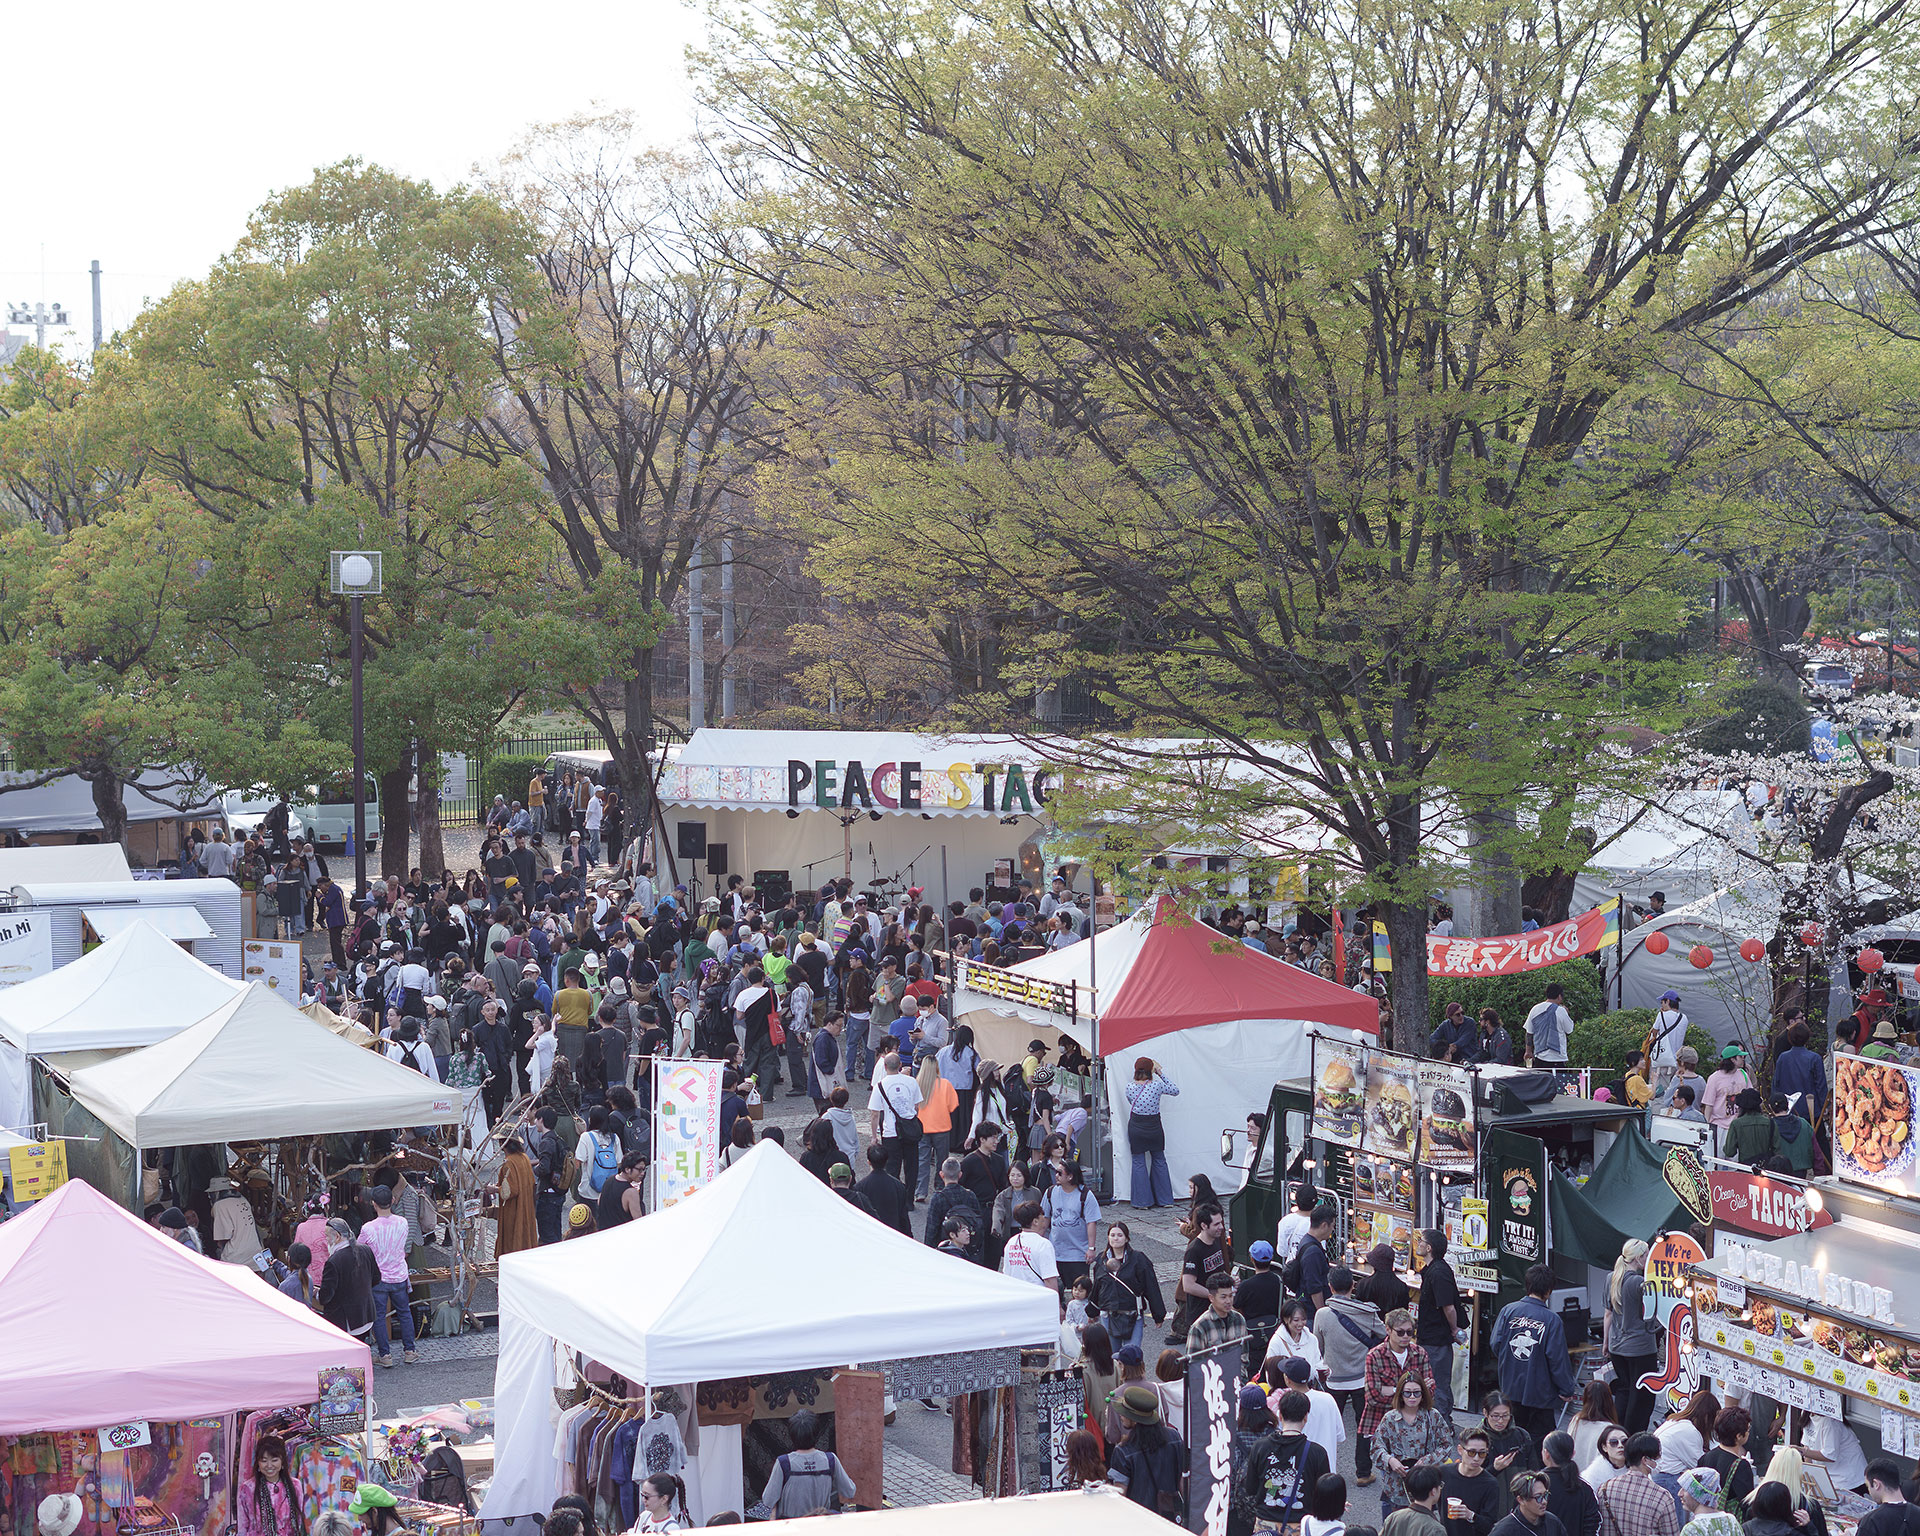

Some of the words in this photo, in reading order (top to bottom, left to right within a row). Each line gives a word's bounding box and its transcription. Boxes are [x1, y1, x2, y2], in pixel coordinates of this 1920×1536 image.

[787, 759, 922, 809] PEACE
[946, 762, 1064, 812] STAG
[15, 918, 31, 935] Mi
[968, 967, 1052, 1007] エコステーション
[1713, 1185, 1736, 1203] Ocean
[1730, 1195, 1749, 1212] Side
[1504, 1219, 1521, 1236] TRY
[1522, 1224, 1535, 1240] IT!
[1508, 1233, 1535, 1250] AWESOME
[1511, 1243, 1530, 1256] TASTE
[1664, 1242, 1692, 1260] We're
[1458, 1250, 1497, 1263] WELCOME
[1458, 1266, 1470, 1275] MY
[1472, 1268, 1494, 1279] SHOP
[1653, 1259, 1675, 1279] TEX
[1719, 1280, 1743, 1294] ORDER
[1726, 1244, 1821, 1302] OCEAN
[1823, 1272, 1896, 1326] SIDE
[1705, 1351, 1712, 1361] A
[1733, 1360, 1739, 1370] B
[1761, 1370, 1768, 1380] C
[1789, 1379, 1796, 1390] D
[1789, 1394, 1804, 1405] 1,700
[1819, 1389, 1826, 1399] E
[1899, 1393, 1910, 1403] 500
[1819, 1404, 1836, 1415] 1,500
